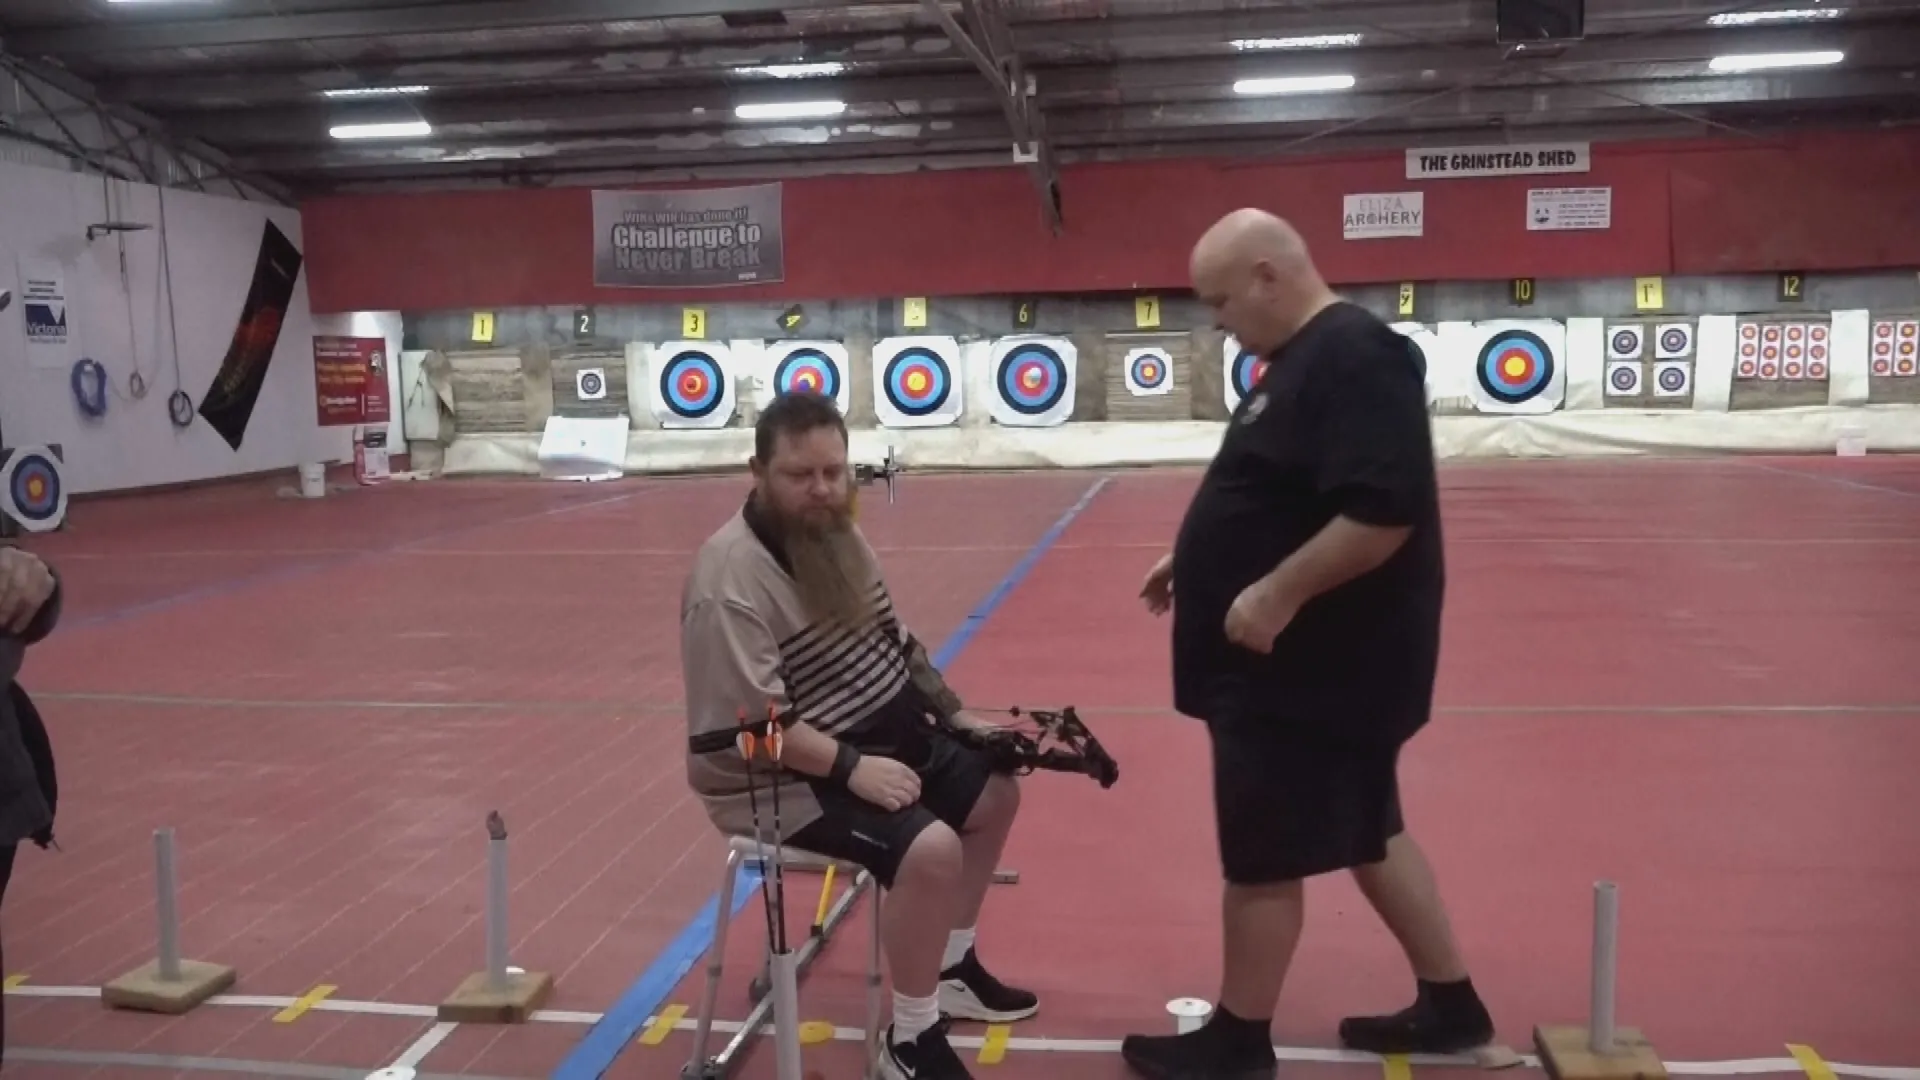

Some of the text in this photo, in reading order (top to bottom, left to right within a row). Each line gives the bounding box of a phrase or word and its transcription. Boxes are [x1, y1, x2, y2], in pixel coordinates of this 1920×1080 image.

[1420, 150, 1577, 172] THE GRINSTEAD SHED
[1359, 196, 1405, 211] ELIZA
[703, 208, 733, 221] done
[612, 223, 761, 249] Challenge to
[614, 245, 760, 271] Never Break
[1515, 279, 1531, 300] 10
[1783, 276, 1799, 296] 12
[1019, 303, 1028, 323] 6
[1144, 301, 1153, 321] 7
[579, 315, 589, 333] 2
[690, 313, 699, 333] 3
